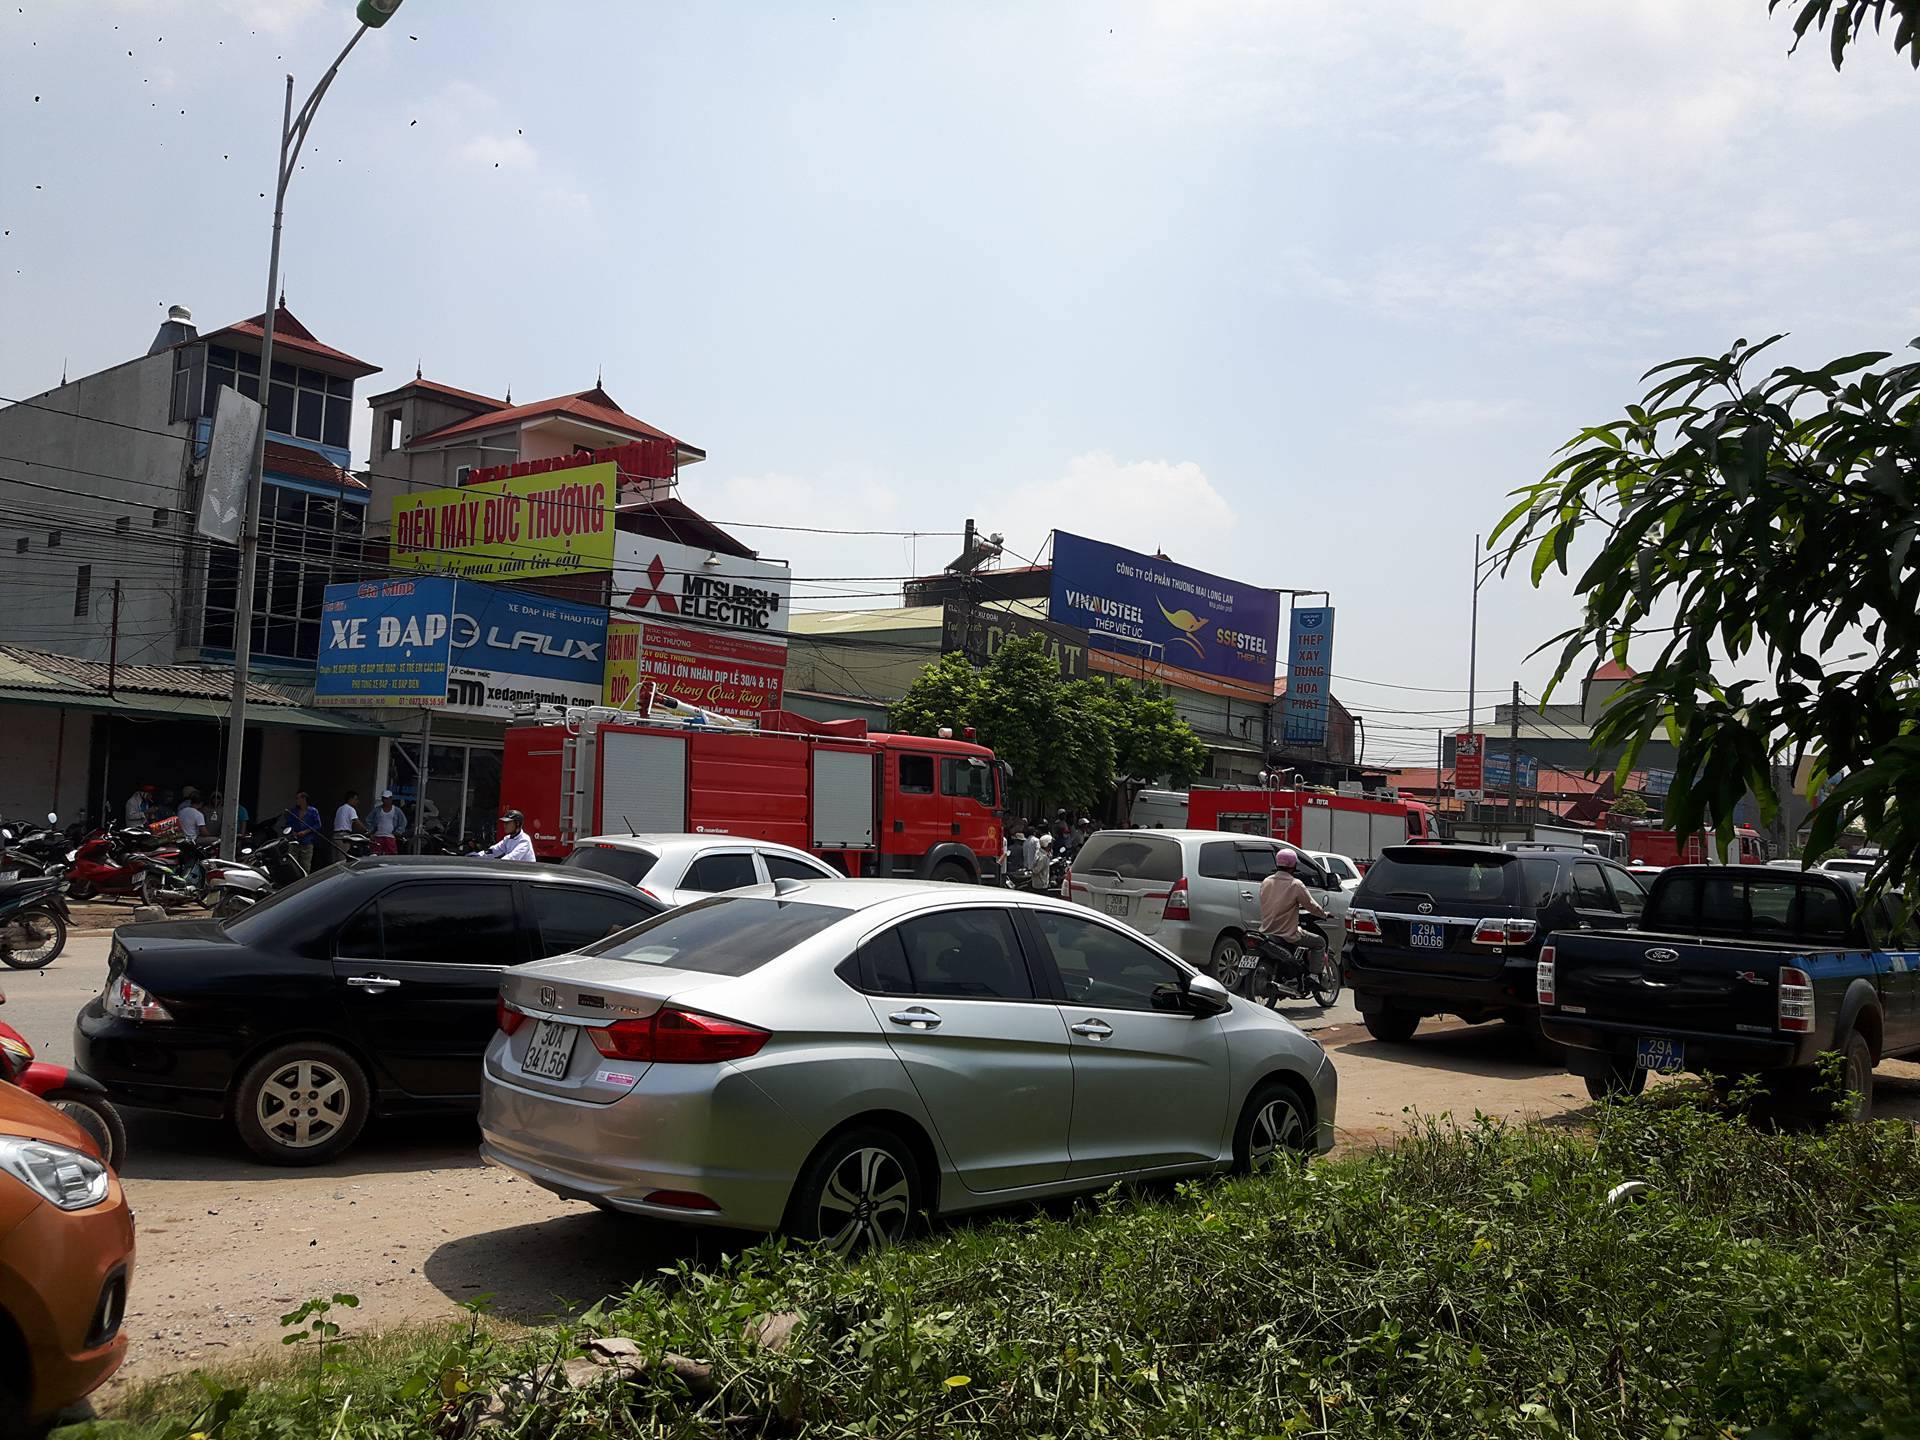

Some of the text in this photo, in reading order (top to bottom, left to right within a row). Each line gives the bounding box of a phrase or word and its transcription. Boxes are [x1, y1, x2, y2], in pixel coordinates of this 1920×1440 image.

[397, 483, 605, 562] ĐIỆN MÁY ĐỨC THƯỢNG
[683, 574, 780, 612] MITSUBISHI
[1116, 562, 1134, 578] CÔNG
[1135, 568, 1143, 580] TY
[1208, 589, 1223, 602] LONG
[1223, 593, 1233, 605] LAN
[508, 603, 519, 613] XE
[522, 606, 540, 617] ĐẠP
[559, 612, 582, 624] THAO
[681, 594, 769, 629] ELECTRIC
[329, 614, 447, 657] XE ĐẠP
[486, 626, 603, 661] LAUX
[1095, 617, 1143, 639] THÉP VIỆT ÚC
[640, 656, 652, 673] ẾN
[654, 661, 670, 676] MÃI
[672, 663, 689, 679] LỚN
[690, 667, 713, 682] NHÂN
[715, 671, 728, 686] DỊP
[740, 674, 757, 688] 30/4
[759, 676, 764, 689] &
[767, 678, 778, 690] 1/5
[1411, 934, 1442, 947] 000.66
[1417, 923, 1436, 936] 29A
[541, 1023, 566, 1049] 30A
[1648, 1039, 1672, 1056] 29A
[525, 1048, 567, 1077] 341.56
